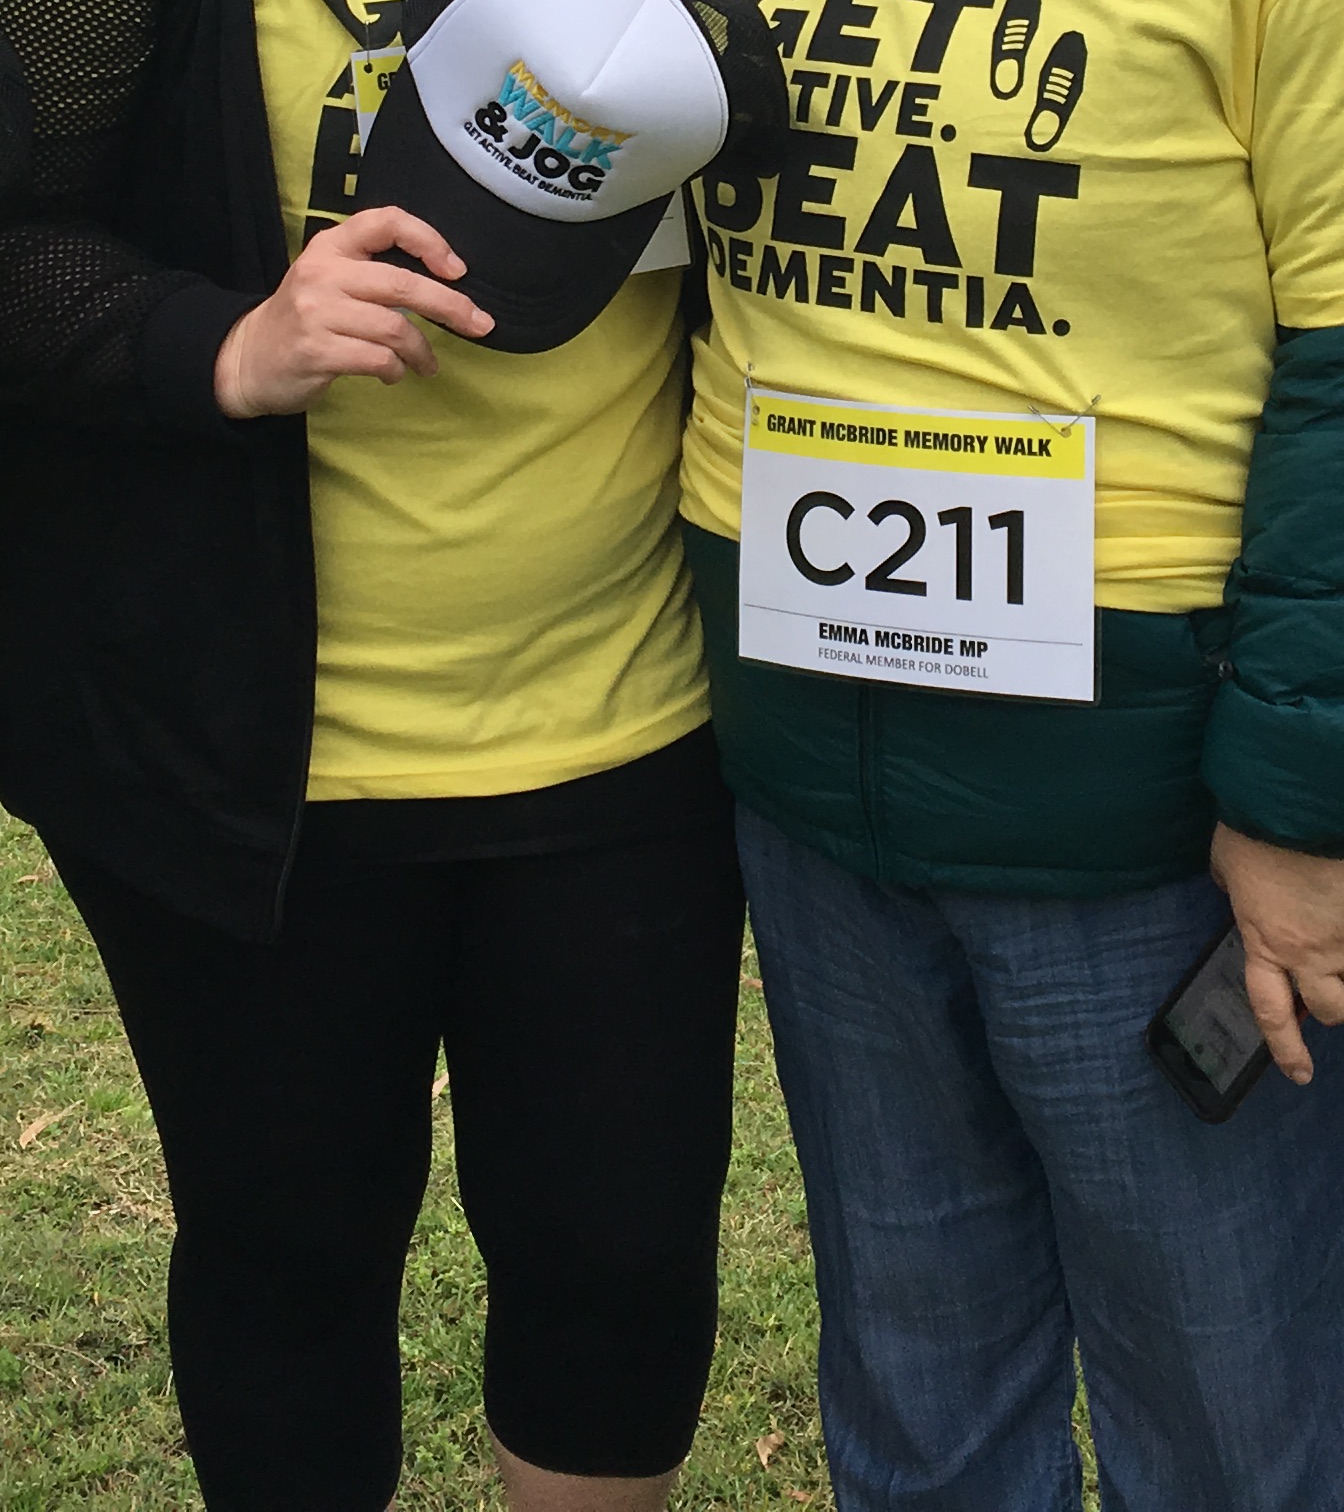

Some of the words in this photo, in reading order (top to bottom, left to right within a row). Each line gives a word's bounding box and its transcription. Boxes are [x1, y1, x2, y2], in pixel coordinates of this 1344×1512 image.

[498, 73, 623, 170] WALK
[789, 69, 957, 142] TIVE.
[474, 101, 509, 143] &
[507, 133, 606, 193] JOG
[707, 226, 1072, 337] DEMENTIA.
[766, 413, 817, 439] GRANT
[820, 421, 899, 448] MCBRIDE
[903, 429, 989, 455] MEMORY
[994, 435, 1053, 458] WALK
[785, 490, 1025, 606] C211
[818, 621, 870, 646] EMMA
[874, 630, 955, 656] MCBRIDE
[959, 639, 989, 659] MP
[818, 647, 864, 666] FEDERAL
[865, 654, 916, 671] MEMBER
[918, 660, 942, 675] FOR
[944, 663, 990, 680] DOBELL
